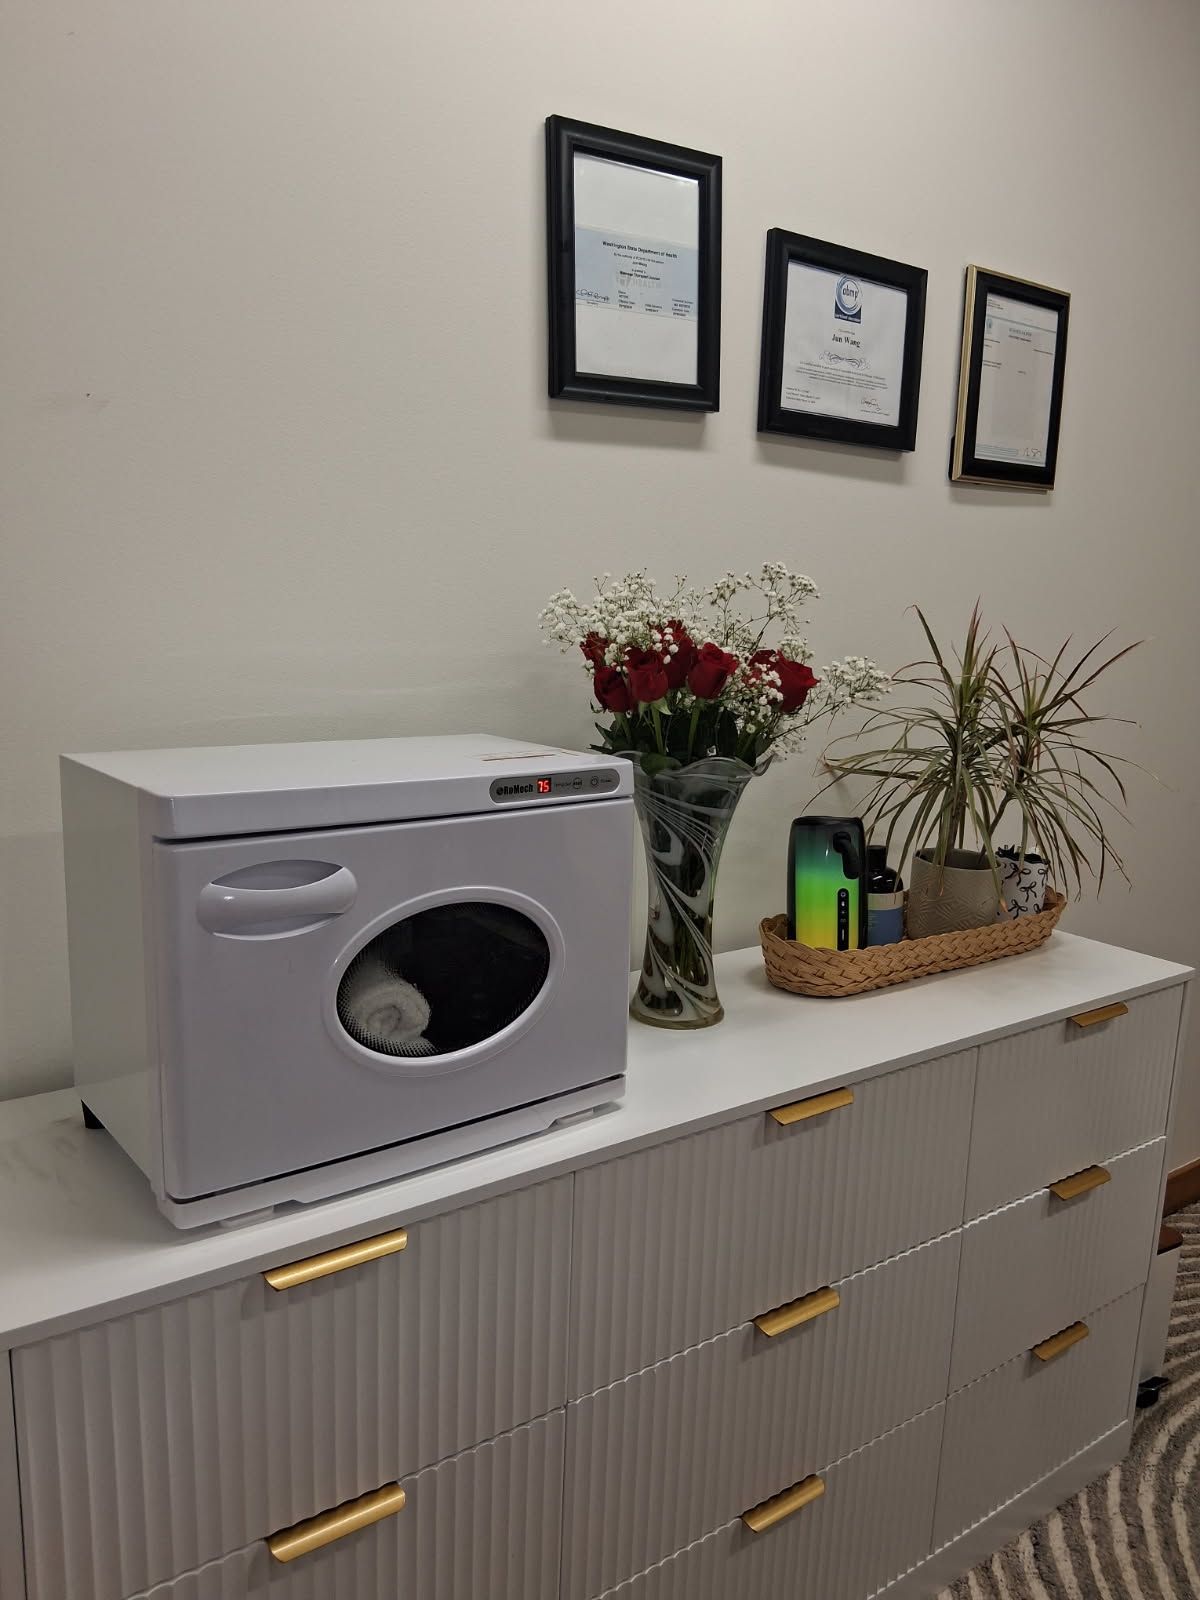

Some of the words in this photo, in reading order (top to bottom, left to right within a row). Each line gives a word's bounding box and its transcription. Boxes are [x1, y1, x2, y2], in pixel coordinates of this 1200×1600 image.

[602, 241, 626, 249] Washington
[638, 248, 660, 256] Department
[832, 334, 843, 343] Jun
[844, 336, 861, 348] Wang
[537, 780, 549, 792] 75
